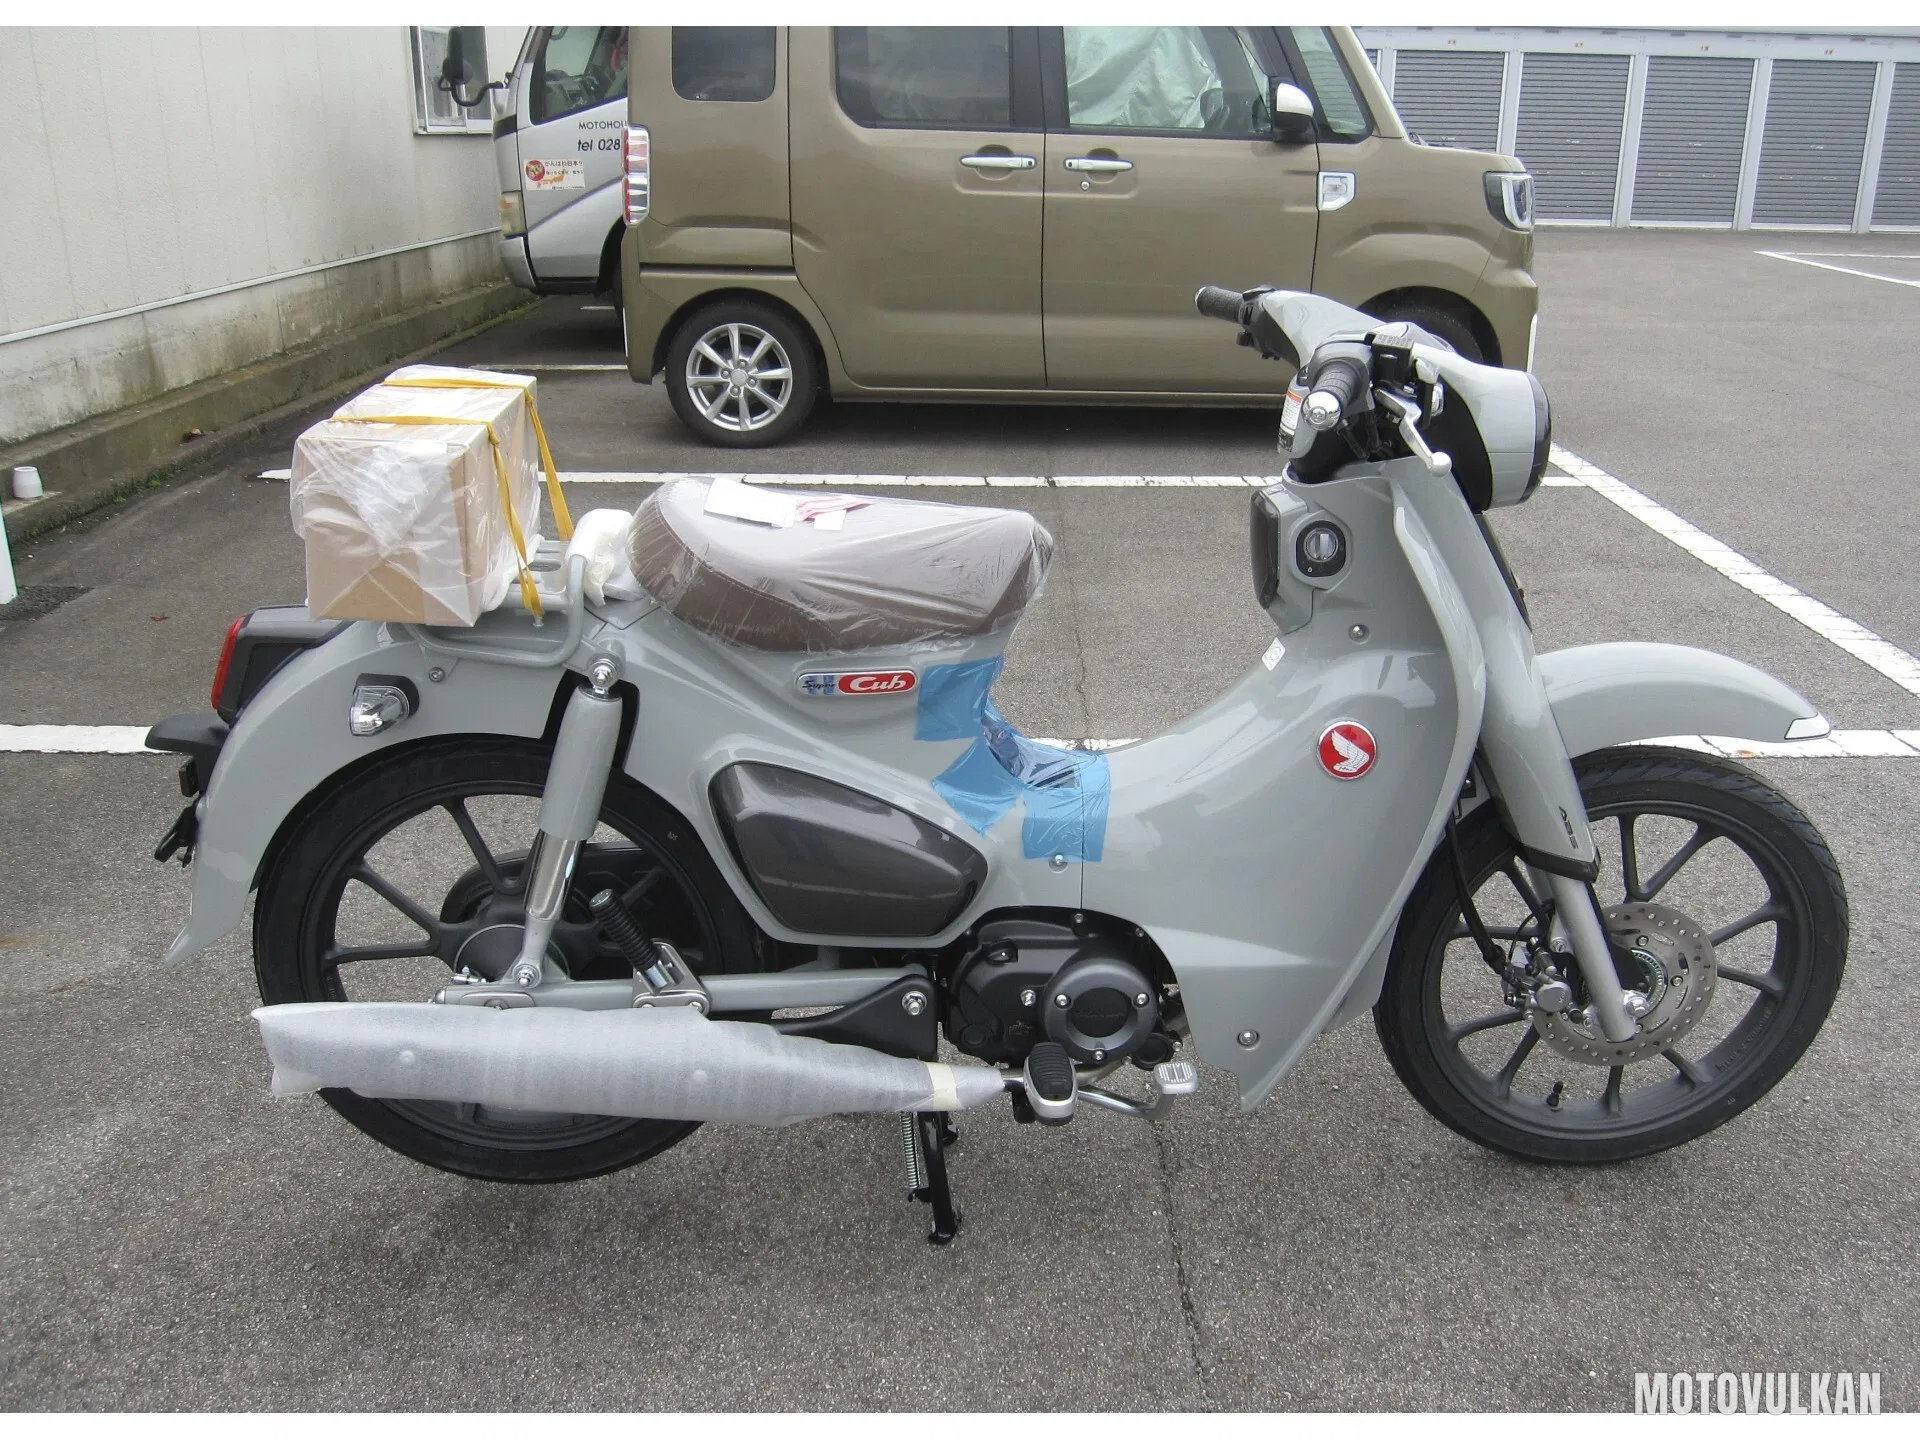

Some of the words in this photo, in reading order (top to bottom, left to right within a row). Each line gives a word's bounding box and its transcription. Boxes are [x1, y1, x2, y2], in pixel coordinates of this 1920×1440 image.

[577, 139, 594, 151] tel
[597, 138, 621, 151] 028
[802, 680, 835, 690] Super
[849, 674, 907, 692] Cub
